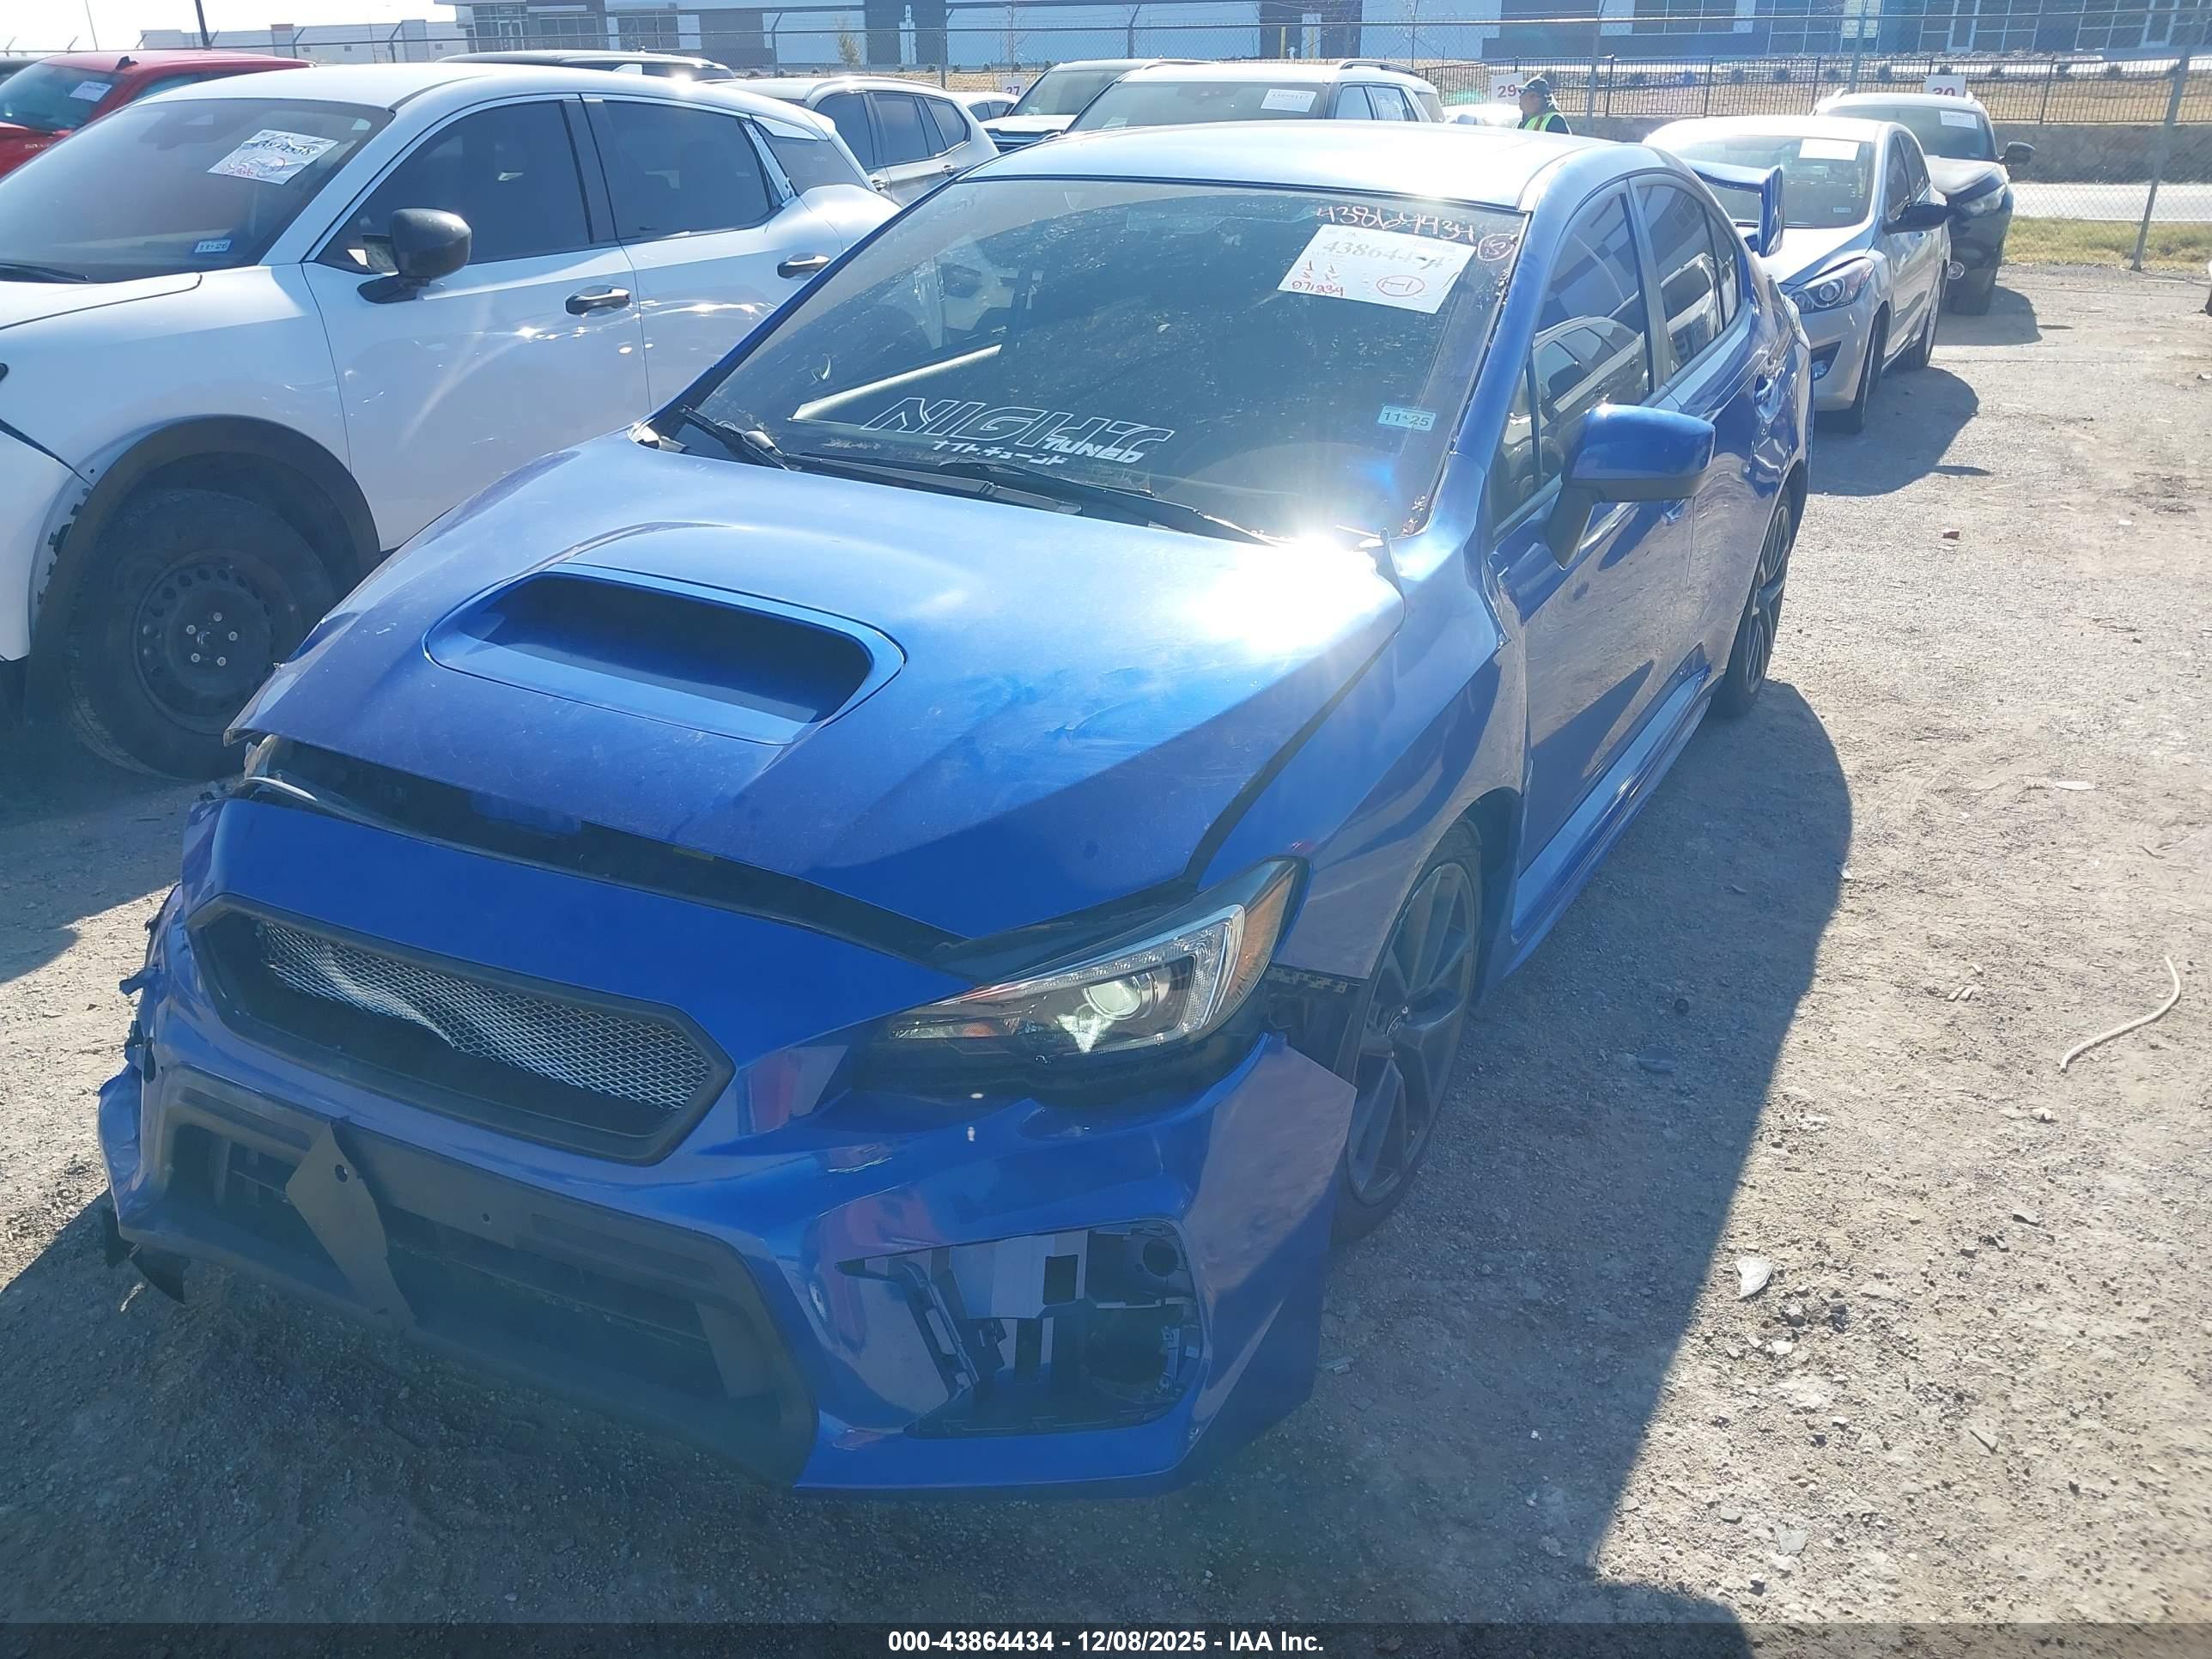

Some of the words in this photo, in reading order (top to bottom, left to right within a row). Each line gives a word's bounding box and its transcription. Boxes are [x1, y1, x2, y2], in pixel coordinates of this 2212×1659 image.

[1497, 83, 1517, 99] 29
[1316, 205, 1475, 244] 43864434
[1042, 436, 1145, 465] TUNED
